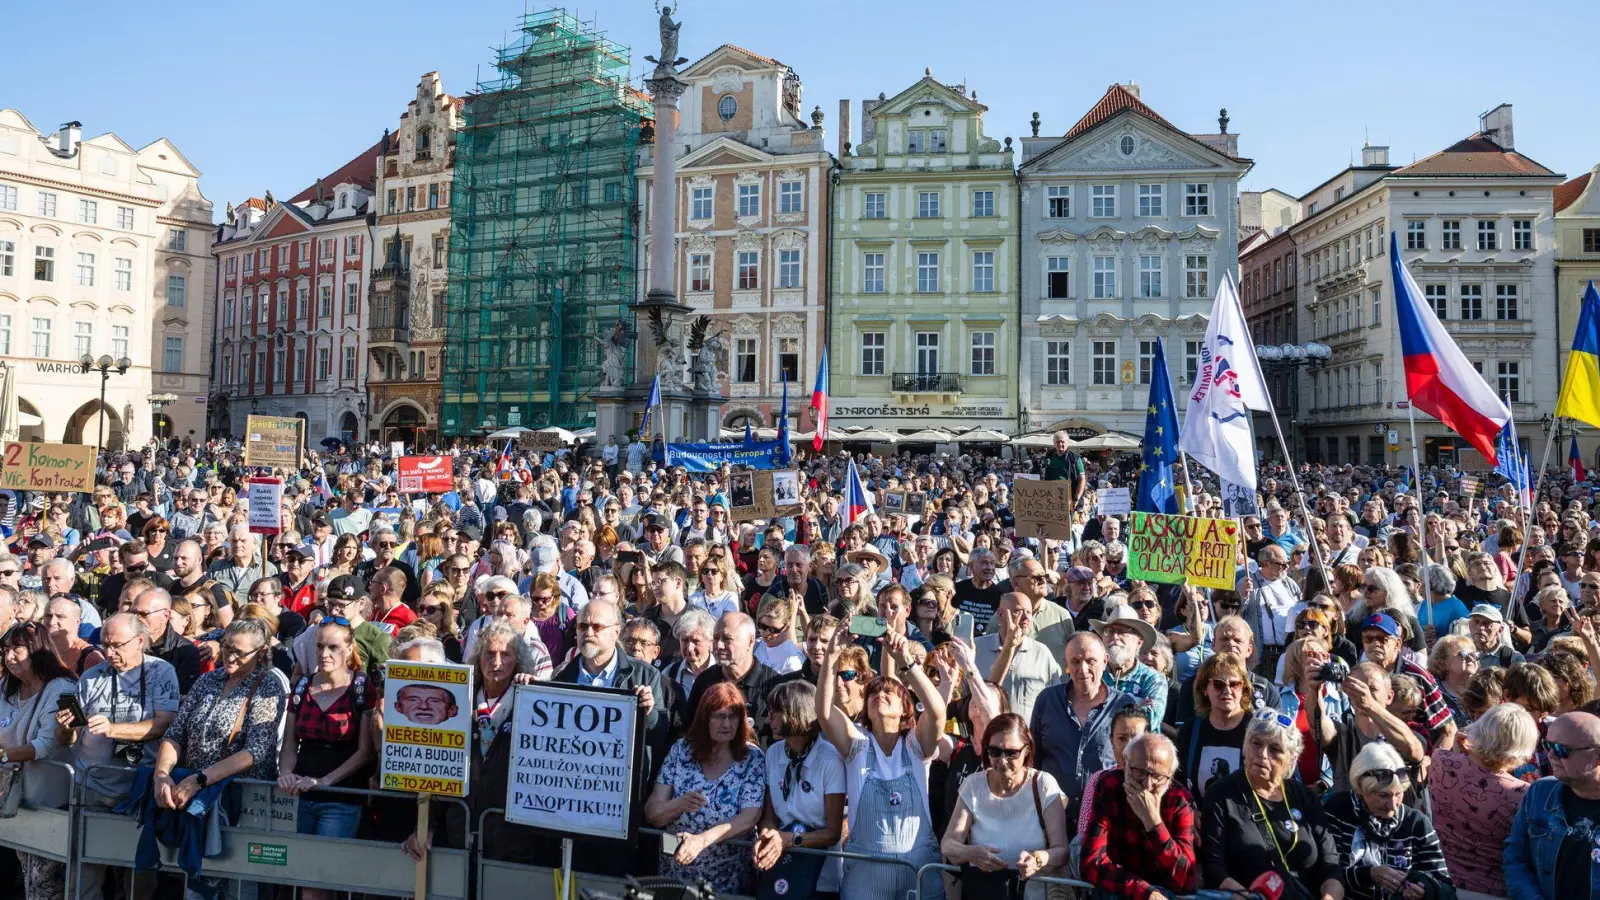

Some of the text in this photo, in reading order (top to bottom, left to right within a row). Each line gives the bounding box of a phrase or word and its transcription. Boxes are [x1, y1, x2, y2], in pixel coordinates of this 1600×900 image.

[1192, 365, 1212, 403] CHVILEK
[835, 404, 930, 416] STAROMĚSTSKÁ
[4, 443, 84, 470] 2 Komory
[669, 450, 721, 459] Budoucnost
[723, 450, 732, 461] je
[734, 450, 765, 458] Evropa
[1204, 519, 1220, 543] A
[1132, 535, 1231, 559] ODVAHOU PROTI
[389, 666, 435, 680] NEZAJÍMÁ
[455, 672, 467, 682] TO
[531, 699, 622, 734] STOP
[386, 727, 464, 746] NEŘEŠÍM TO
[520, 733, 625, 760] BUREŠOVĚ
[386, 745, 464, 763] CHCI A BUDU!!
[385, 758, 463, 777] ČERPAT DOTACE
[517, 756, 625, 777] ZADLUŽOVACÍMU
[419, 779, 463, 793] ZAPLATÍ
[516, 771, 625, 793] RUDOHNĚDÉMU
[514, 791, 622, 818] PANOPTIKU!!!
